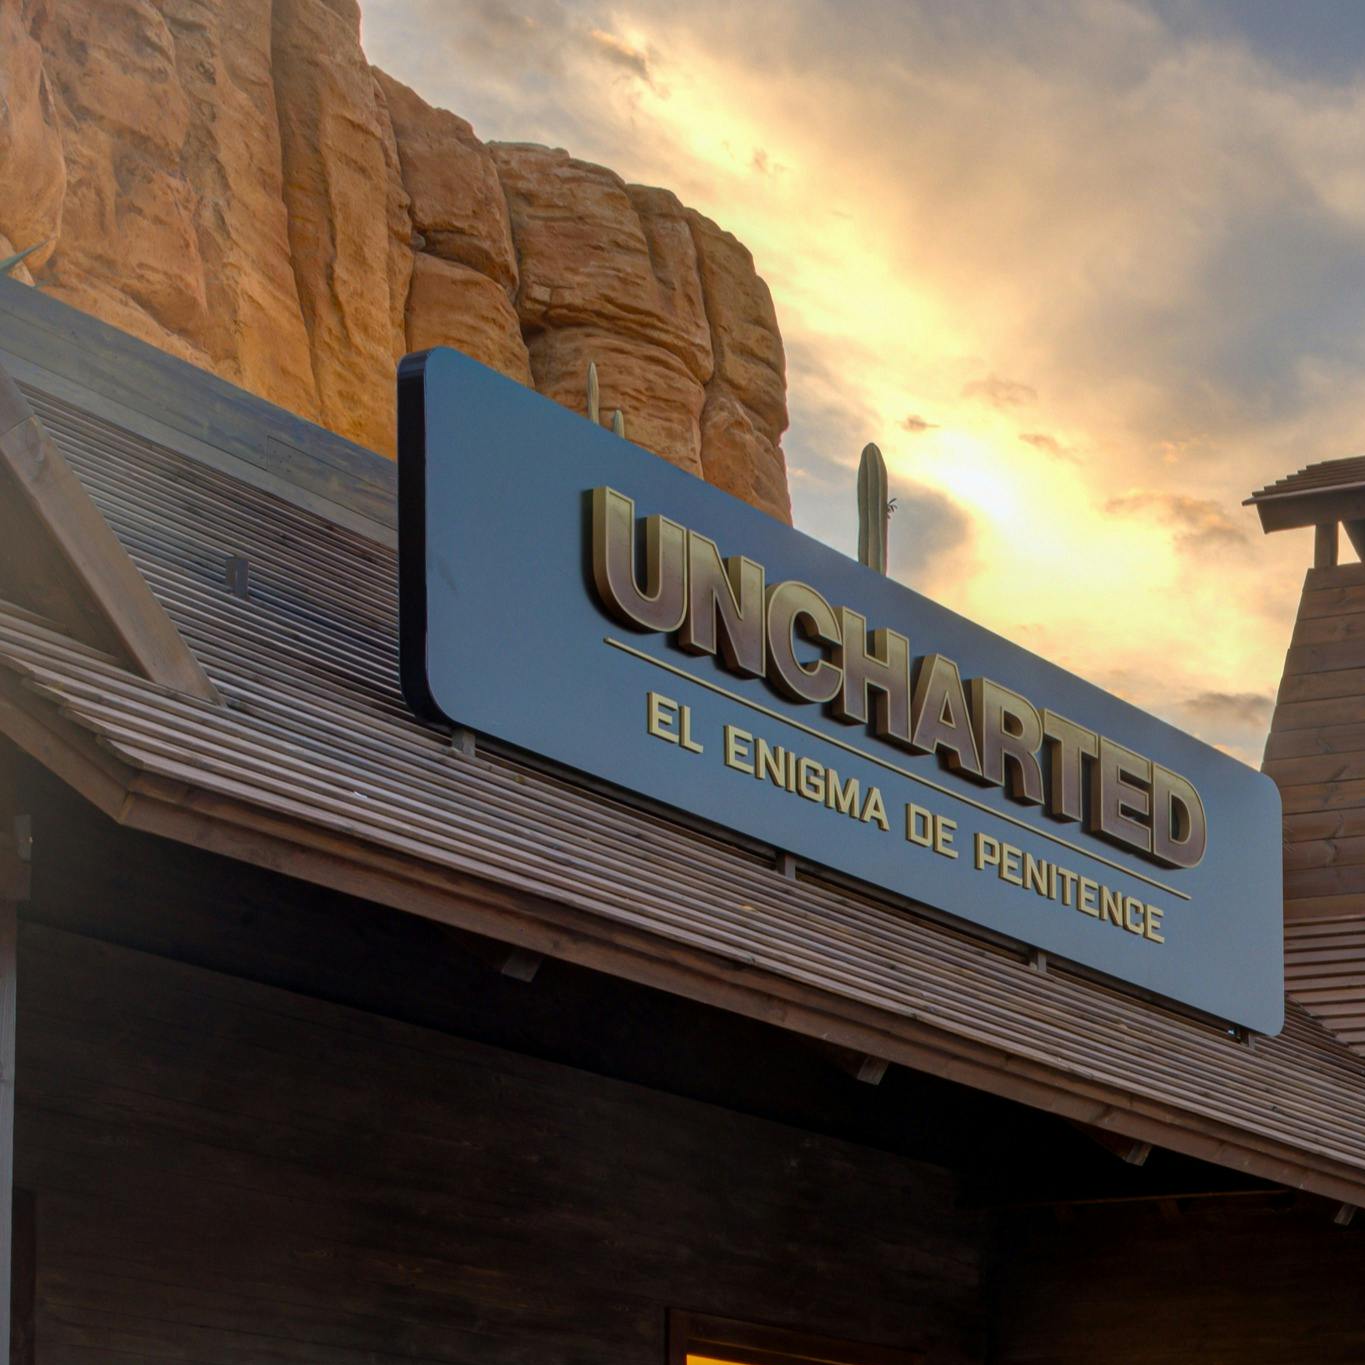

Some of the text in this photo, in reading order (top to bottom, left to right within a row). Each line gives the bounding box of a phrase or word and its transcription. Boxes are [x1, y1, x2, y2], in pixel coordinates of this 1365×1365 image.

[593, 486, 1207, 868] UNCHARTED
[648, 691, 1165, 943] EL ENIGMA DE PENITENCE
